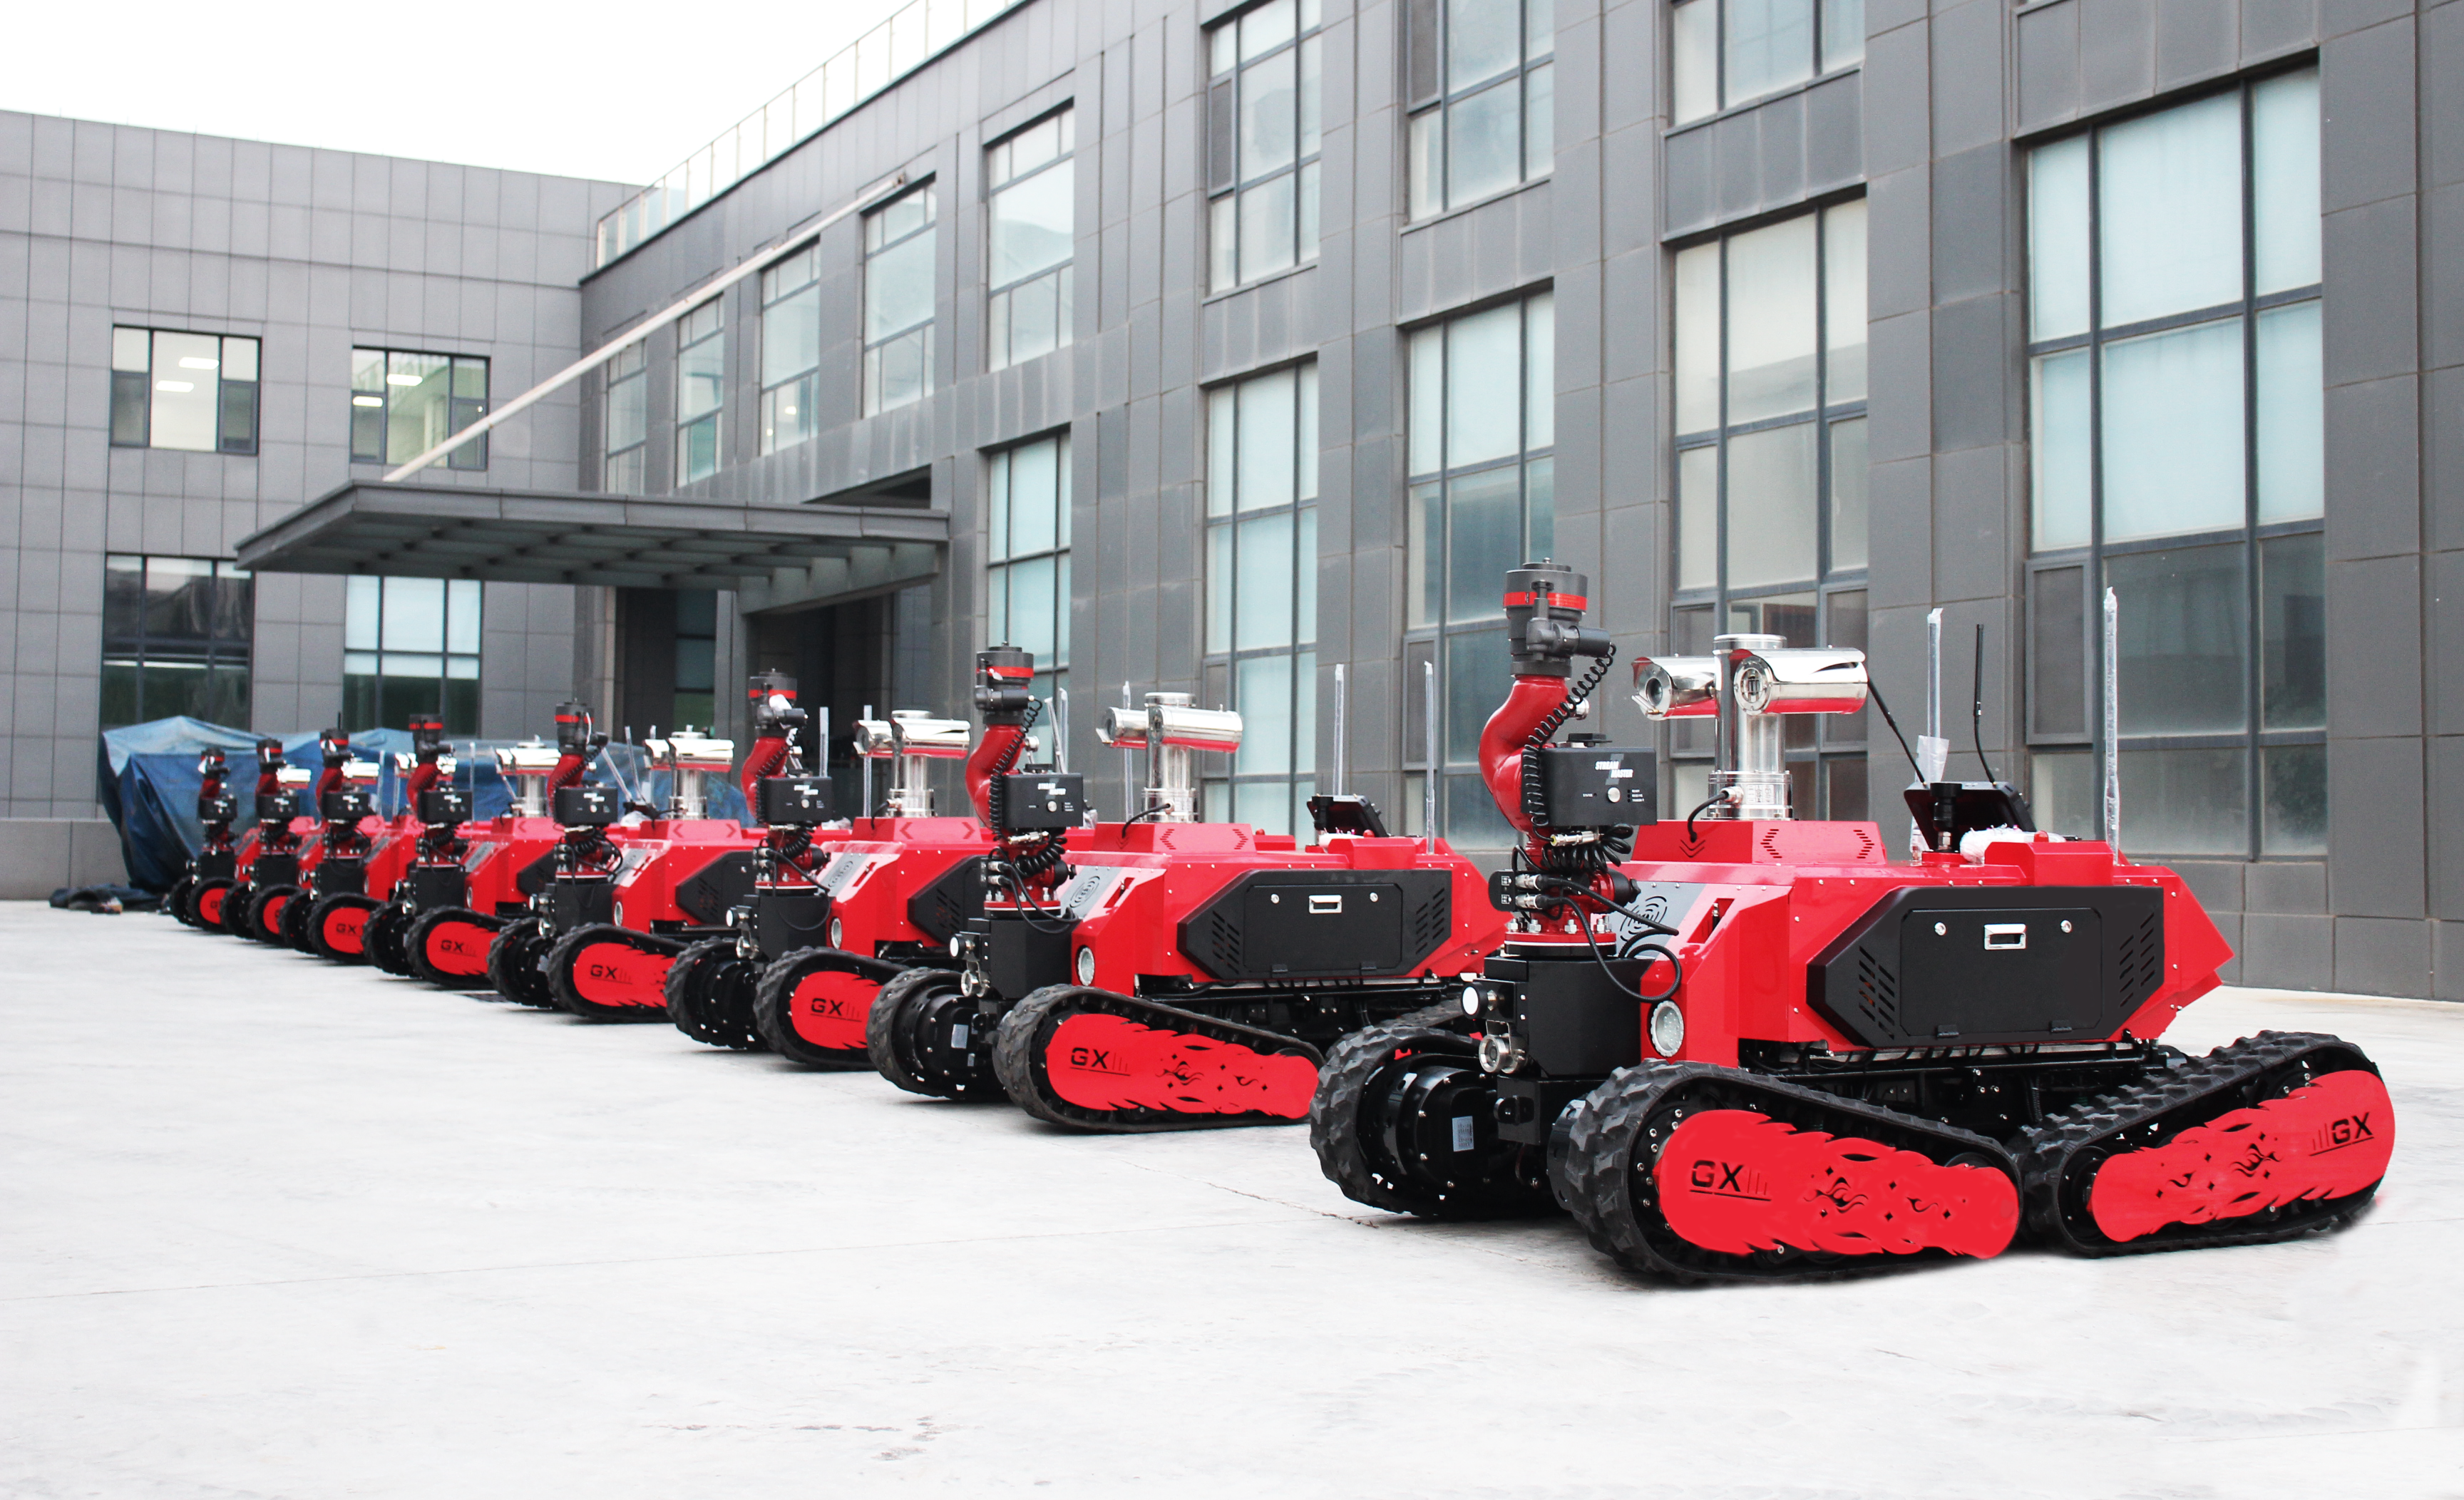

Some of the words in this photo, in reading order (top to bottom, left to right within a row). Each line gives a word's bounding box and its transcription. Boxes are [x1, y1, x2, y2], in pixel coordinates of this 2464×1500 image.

[1595, 761, 1619, 770] STREAM
[1611, 769, 1633, 778] MASTER
[441, 940, 464, 952] GX
[590, 965, 617, 980] GX
[811, 997, 844, 1016] GX
[1071, 1047, 1109, 1069] GX
[2332, 1112, 2373, 1145] GX
[1691, 1160, 1744, 1192] GX
